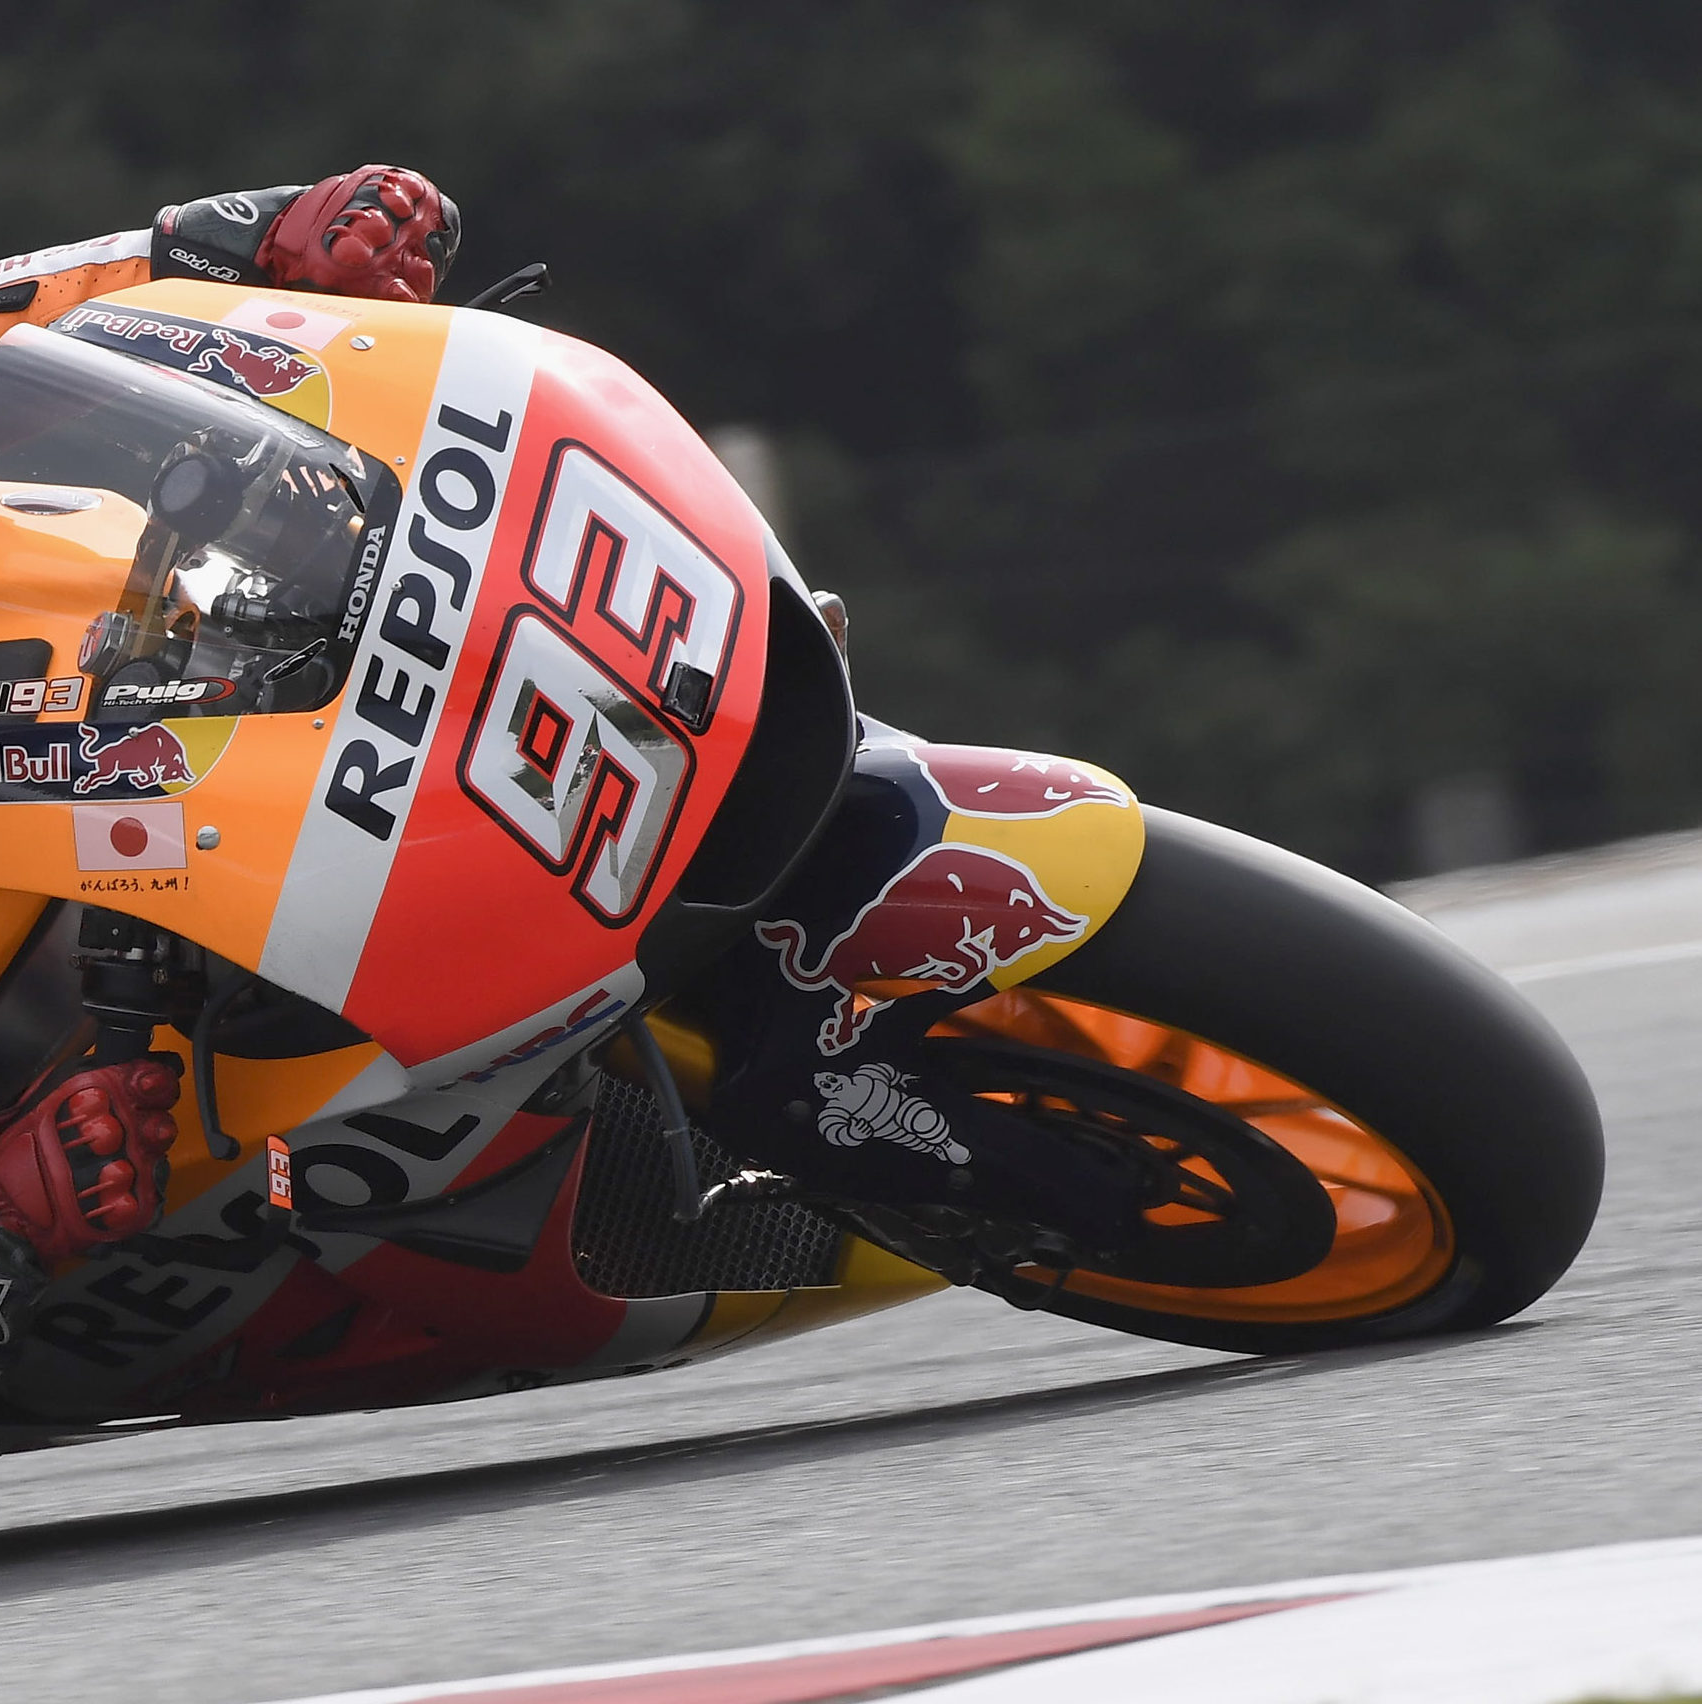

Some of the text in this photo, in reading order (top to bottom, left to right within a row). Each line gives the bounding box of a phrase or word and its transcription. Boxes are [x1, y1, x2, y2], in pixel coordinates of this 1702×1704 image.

[57, 307, 210, 355] Red Bull
[337, 525, 387, 644] HONDA
[324, 403, 513, 842] REPSOL
[103, 680, 209, 701] Puig
[145, 697, 174, 705] Parts
[456, 437, 745, 929] 93
[3, 743, 71, 783] Bull
[270, 1149, 291, 1200] 93
